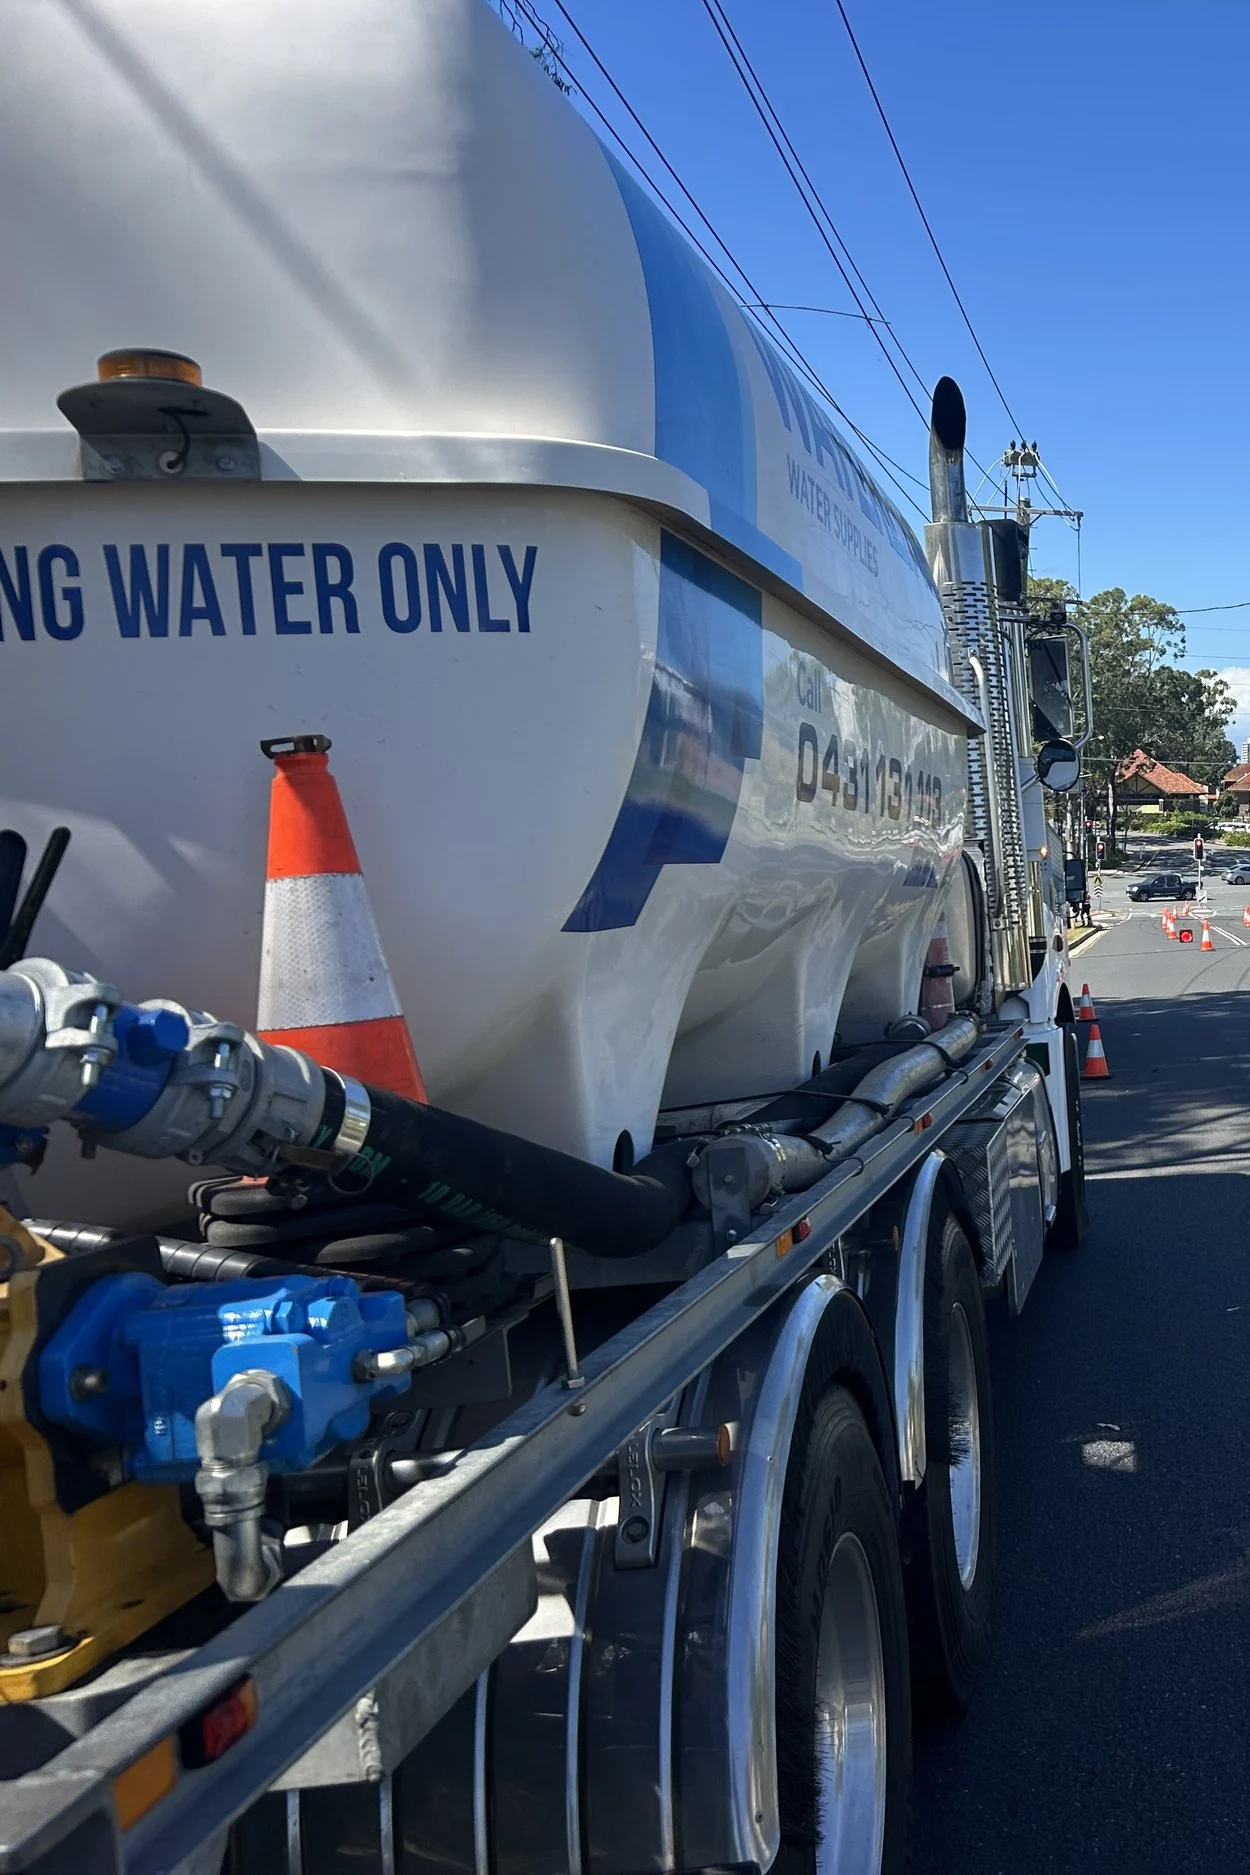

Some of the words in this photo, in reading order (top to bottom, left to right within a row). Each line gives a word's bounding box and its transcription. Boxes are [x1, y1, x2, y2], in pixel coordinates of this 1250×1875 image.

[786, 453, 831, 529] WATER
[833, 503, 880, 579] SUPPLIES
[103, 543, 361, 638] WATER
[377, 541, 539, 634] ONLY
[796, 662, 822, 714] Call
[796, 721, 871, 815] 0431
[874, 754, 914, 822] 131
